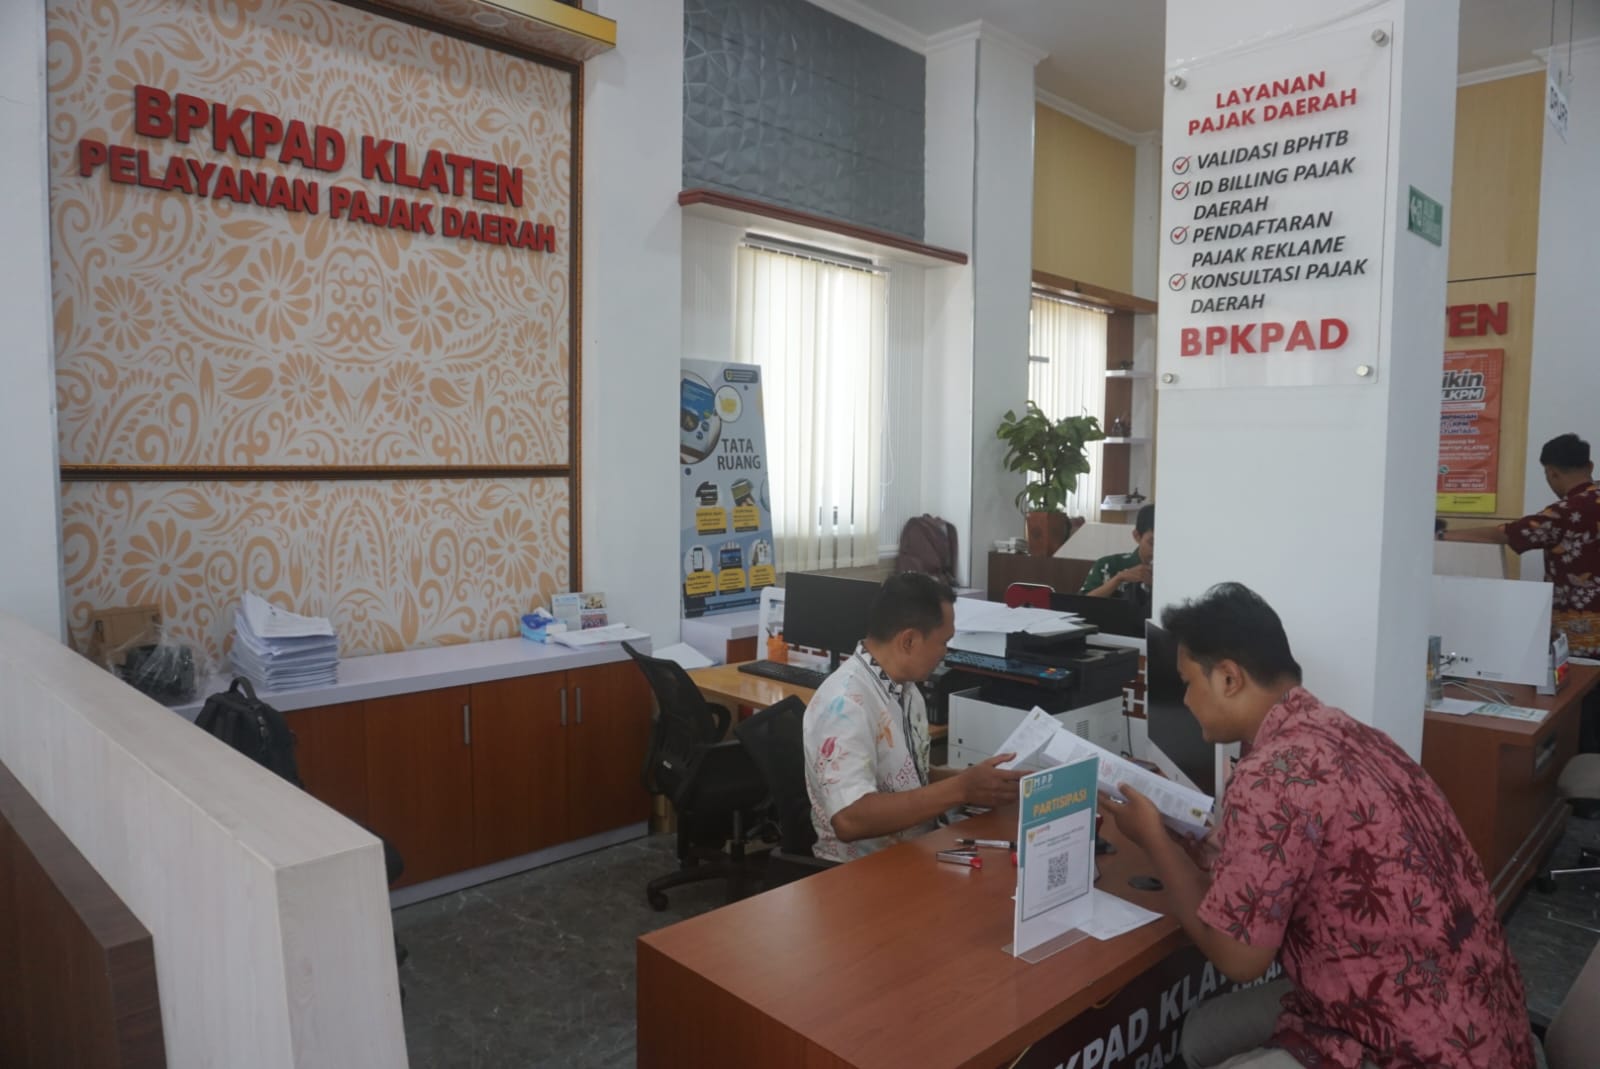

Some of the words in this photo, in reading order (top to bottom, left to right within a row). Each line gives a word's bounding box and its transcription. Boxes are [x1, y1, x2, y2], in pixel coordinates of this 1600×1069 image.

[1215, 71, 1326, 109] LAYANAN
[1187, 108, 1257, 136] PAJAK
[1262, 88, 1358, 123] DAERAH
[134, 84, 346, 172] BPKPAD
[361, 134, 524, 207] KLATEN
[1197, 142, 1279, 170] VALIDASI
[1282, 129, 1350, 156] BPHTB
[1194, 179, 1214, 197] ID
[1217, 167, 1289, 194] BILLING
[1293, 156, 1356, 182] PAJAK
[78, 139, 319, 215] PELAYANAN
[330, 185, 436, 235] PAJAK
[441, 206, 556, 253] DAERAH
[1193, 195, 1269, 221] DAERAH
[1192, 210, 1333, 244] PENDAFTARAN
[1191, 246, 1248, 268] PAJAK
[1251, 235, 1346, 262] REKLAME
[1191, 264, 1301, 291] KONSULTASI
[1305, 258, 1369, 280] PAJAK
[1190, 293, 1265, 315] DAERAH
[1446, 302, 1509, 338] EN
[1180, 318, 1350, 358] BPKPAD
[717, 455, 762, 471] RUANG
[721, 438, 754, 454] TATA
[1032, 788, 1087, 817] PARTISIPASI
[1159, 960, 1227, 1031] KLA
[1135, 1029, 1179, 1069] PAJ
